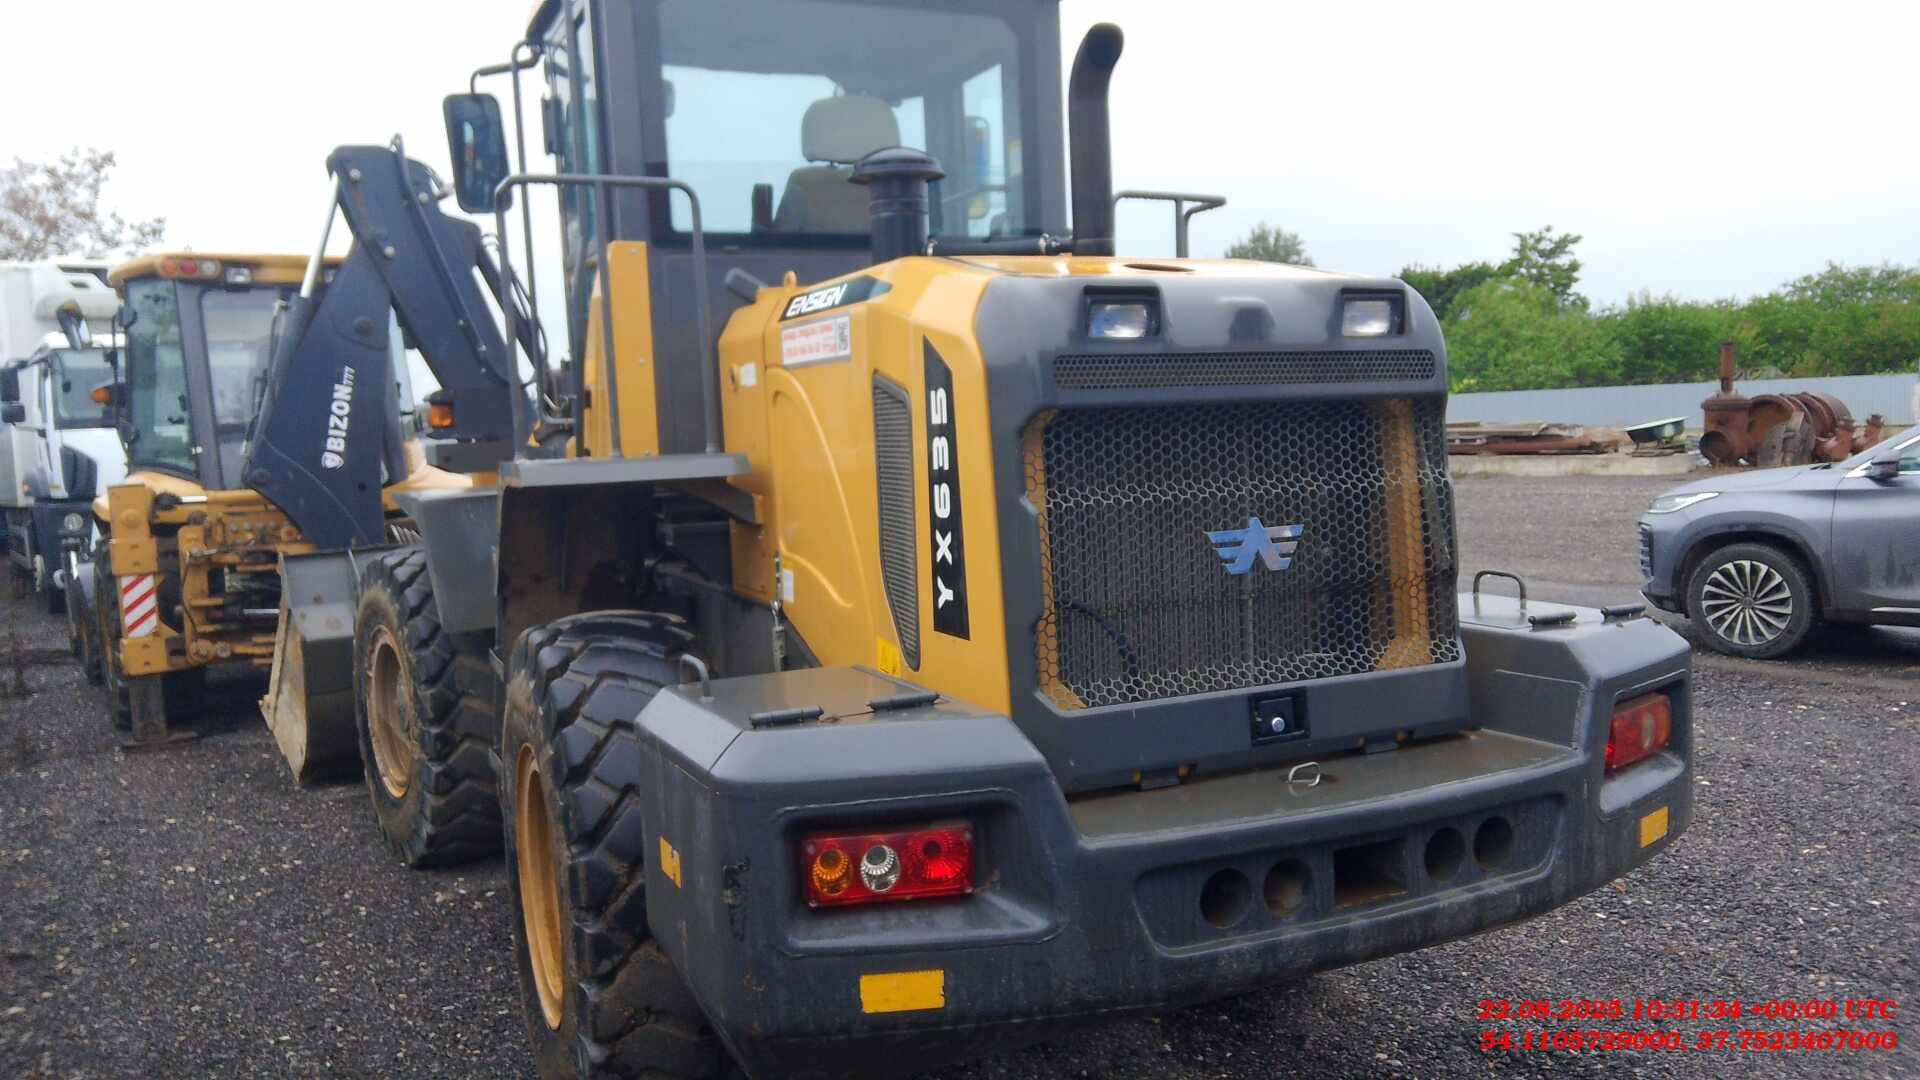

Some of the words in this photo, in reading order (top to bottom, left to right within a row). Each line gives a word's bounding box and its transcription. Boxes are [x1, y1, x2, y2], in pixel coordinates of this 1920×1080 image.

[785, 283, 848, 318] ENSIGN
[326, 383, 354, 452] BIZON
[930, 386, 955, 610] YX635
